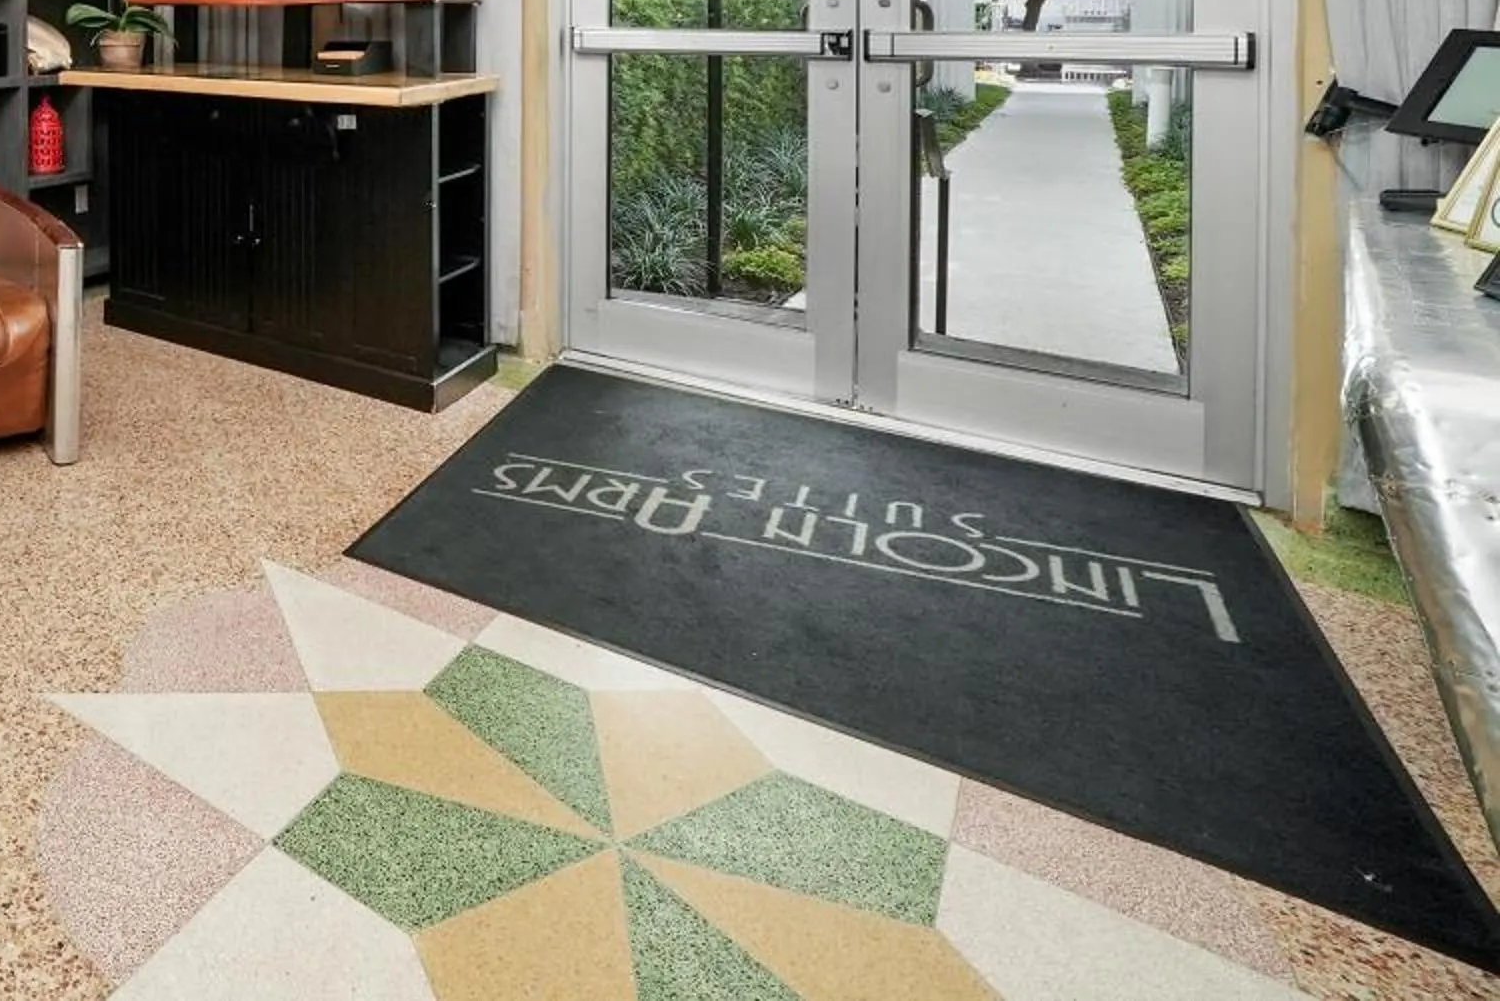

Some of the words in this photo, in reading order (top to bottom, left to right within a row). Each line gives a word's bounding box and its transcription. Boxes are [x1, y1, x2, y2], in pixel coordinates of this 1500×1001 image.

[492, 463, 713, 536] ARMS
[681, 469, 985, 539] SUITES
[762, 506, 1242, 644] LINCOLN
